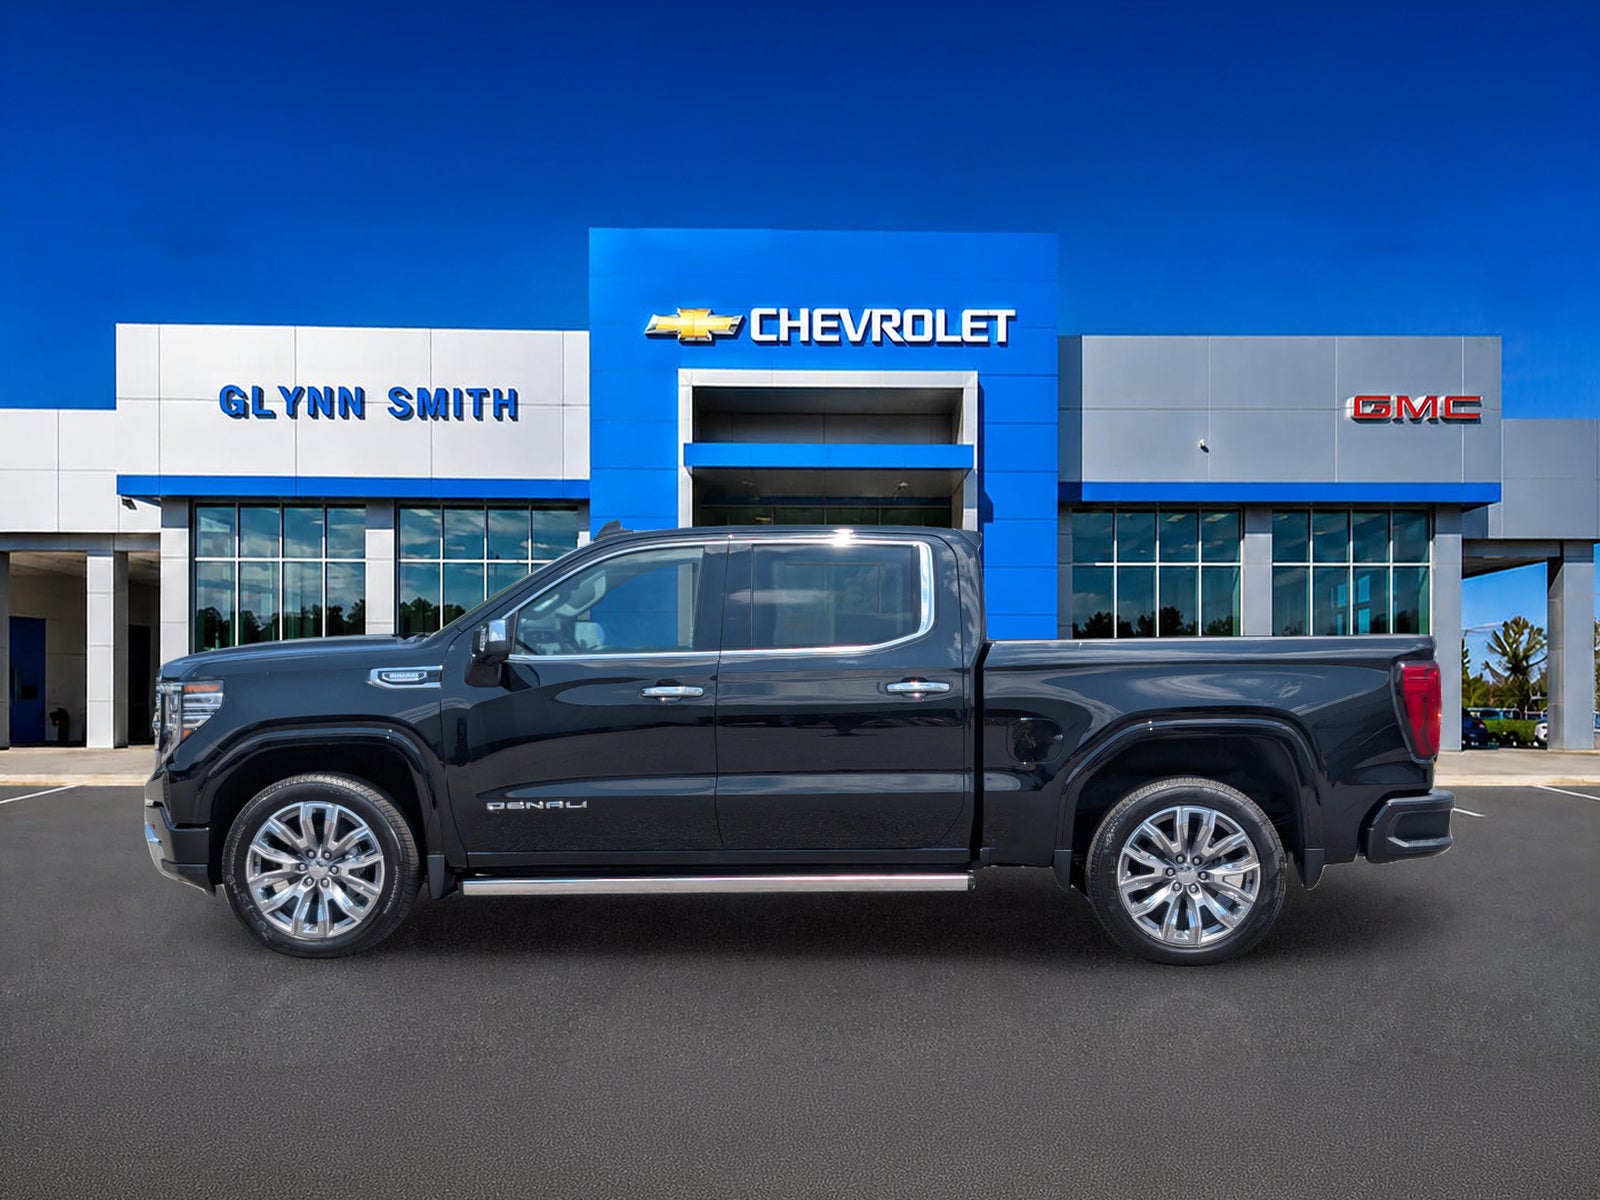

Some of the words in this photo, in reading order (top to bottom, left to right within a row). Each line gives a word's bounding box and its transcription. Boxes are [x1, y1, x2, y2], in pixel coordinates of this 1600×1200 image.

[750, 307, 1017, 346] CHEVROLET
[218, 384, 366, 420] GLYNN
[387, 386, 519, 422] SMITH
[1350, 394, 1482, 424] GMC
[486, 800, 588, 811] DENALI
